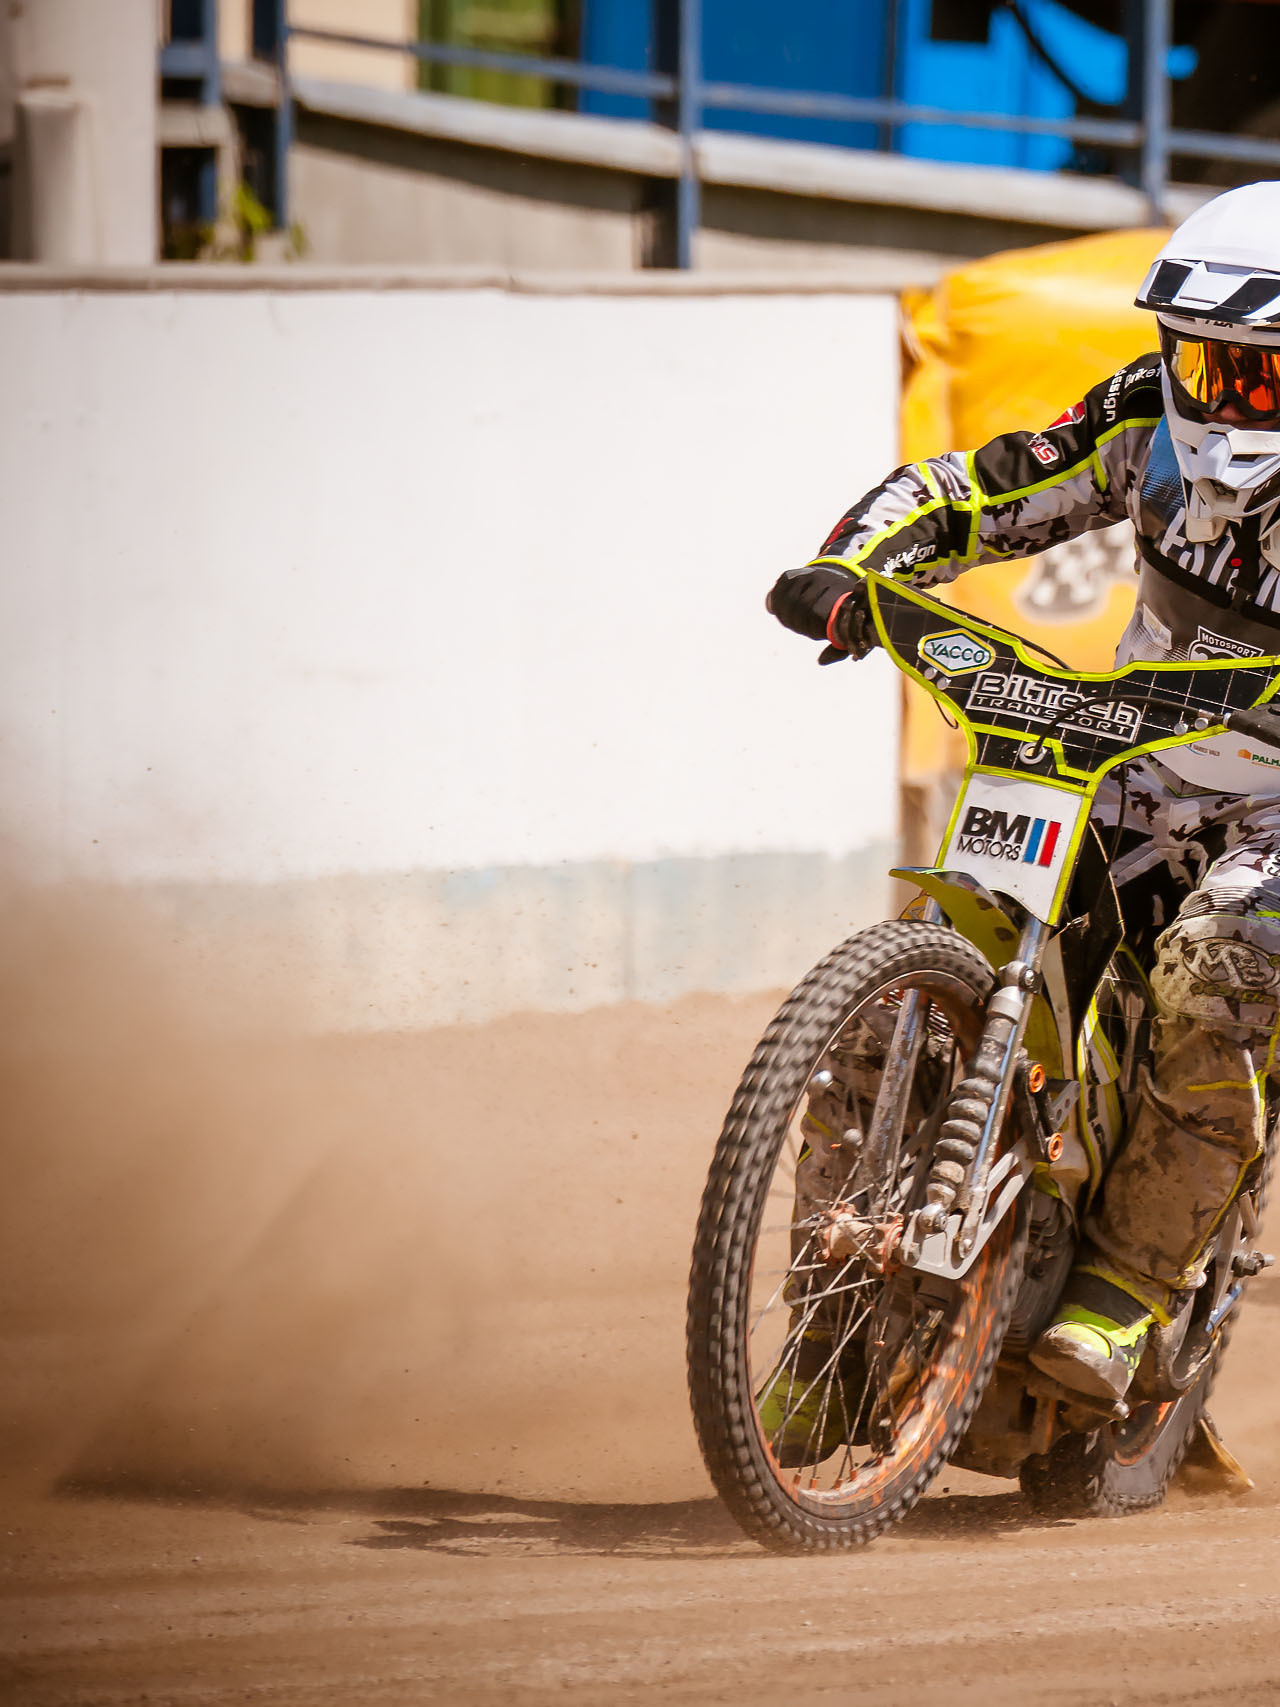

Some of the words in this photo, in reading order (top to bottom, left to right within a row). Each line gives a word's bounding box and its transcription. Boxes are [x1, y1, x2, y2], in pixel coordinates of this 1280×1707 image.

[929, 641, 985, 664] YACCO
[1201, 632, 1258, 658] MOTOSPORT
[960, 805, 1031, 845] BM
[956, 836, 1022, 861] MOTORS
